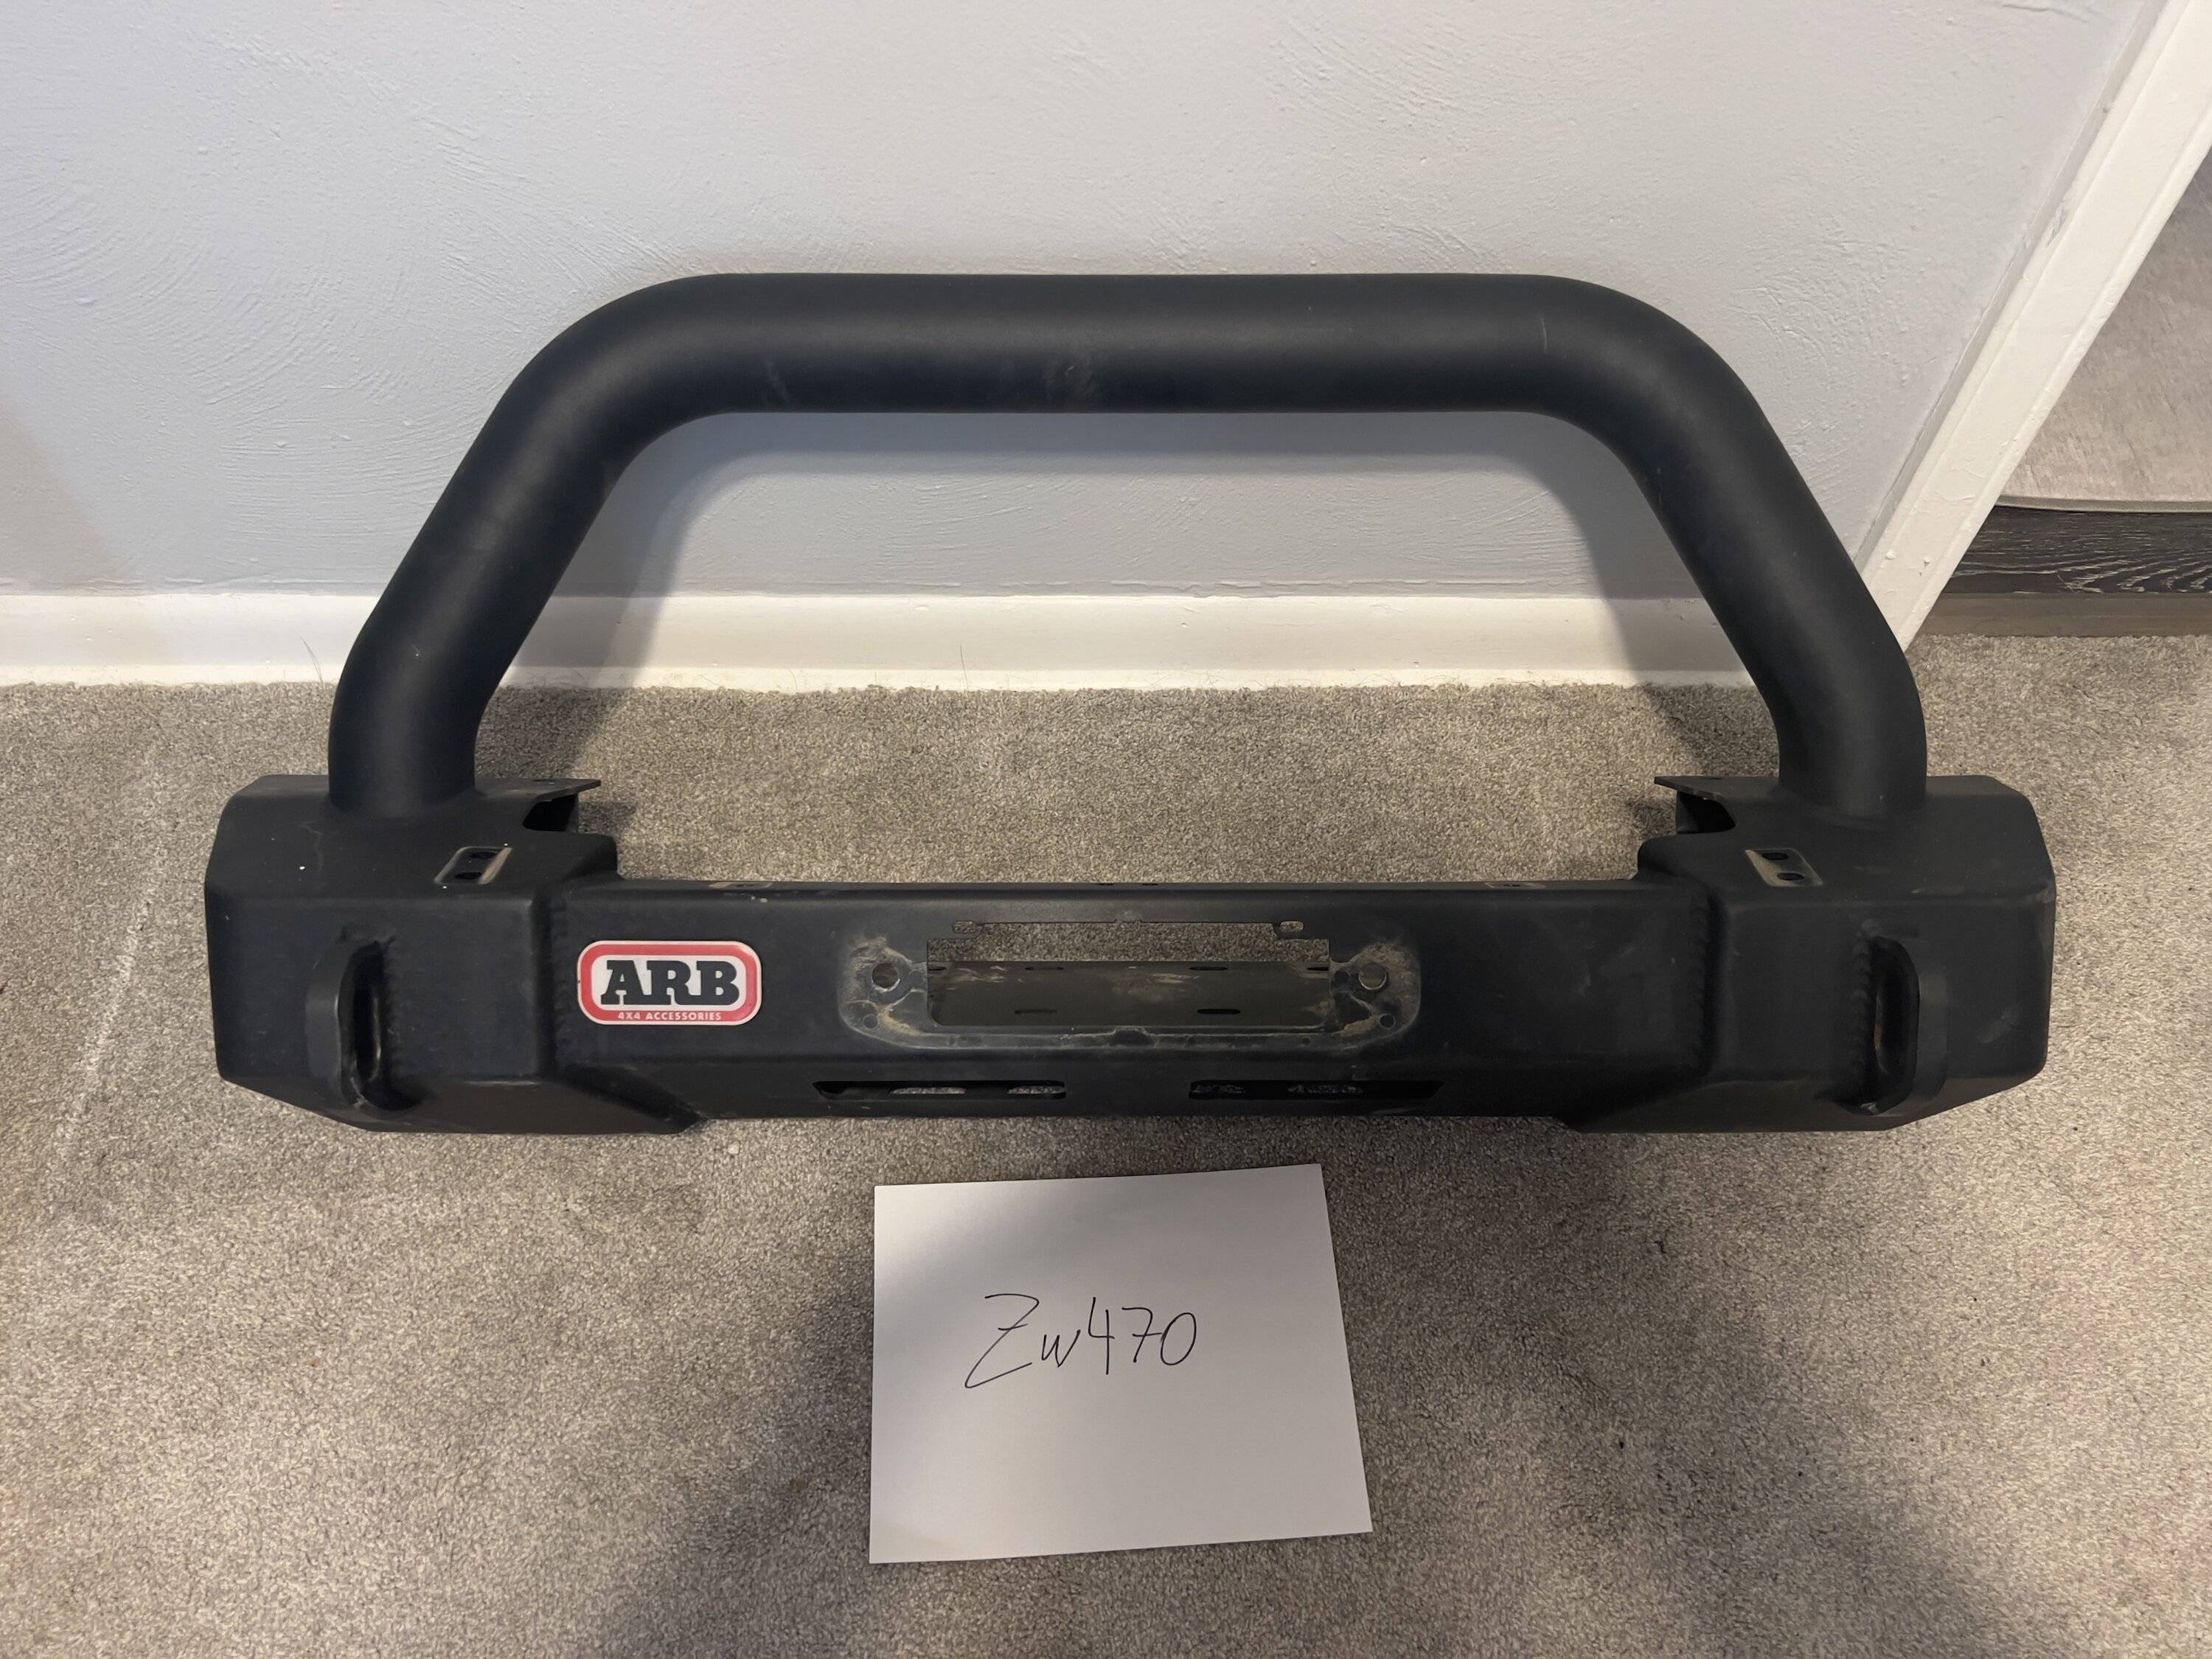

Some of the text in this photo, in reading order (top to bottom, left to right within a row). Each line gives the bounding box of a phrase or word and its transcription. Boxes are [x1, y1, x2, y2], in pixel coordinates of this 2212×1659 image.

[601, 960, 740, 1005] ARB
[618, 1012, 722, 1020] 4X4 ACCESSORIES
